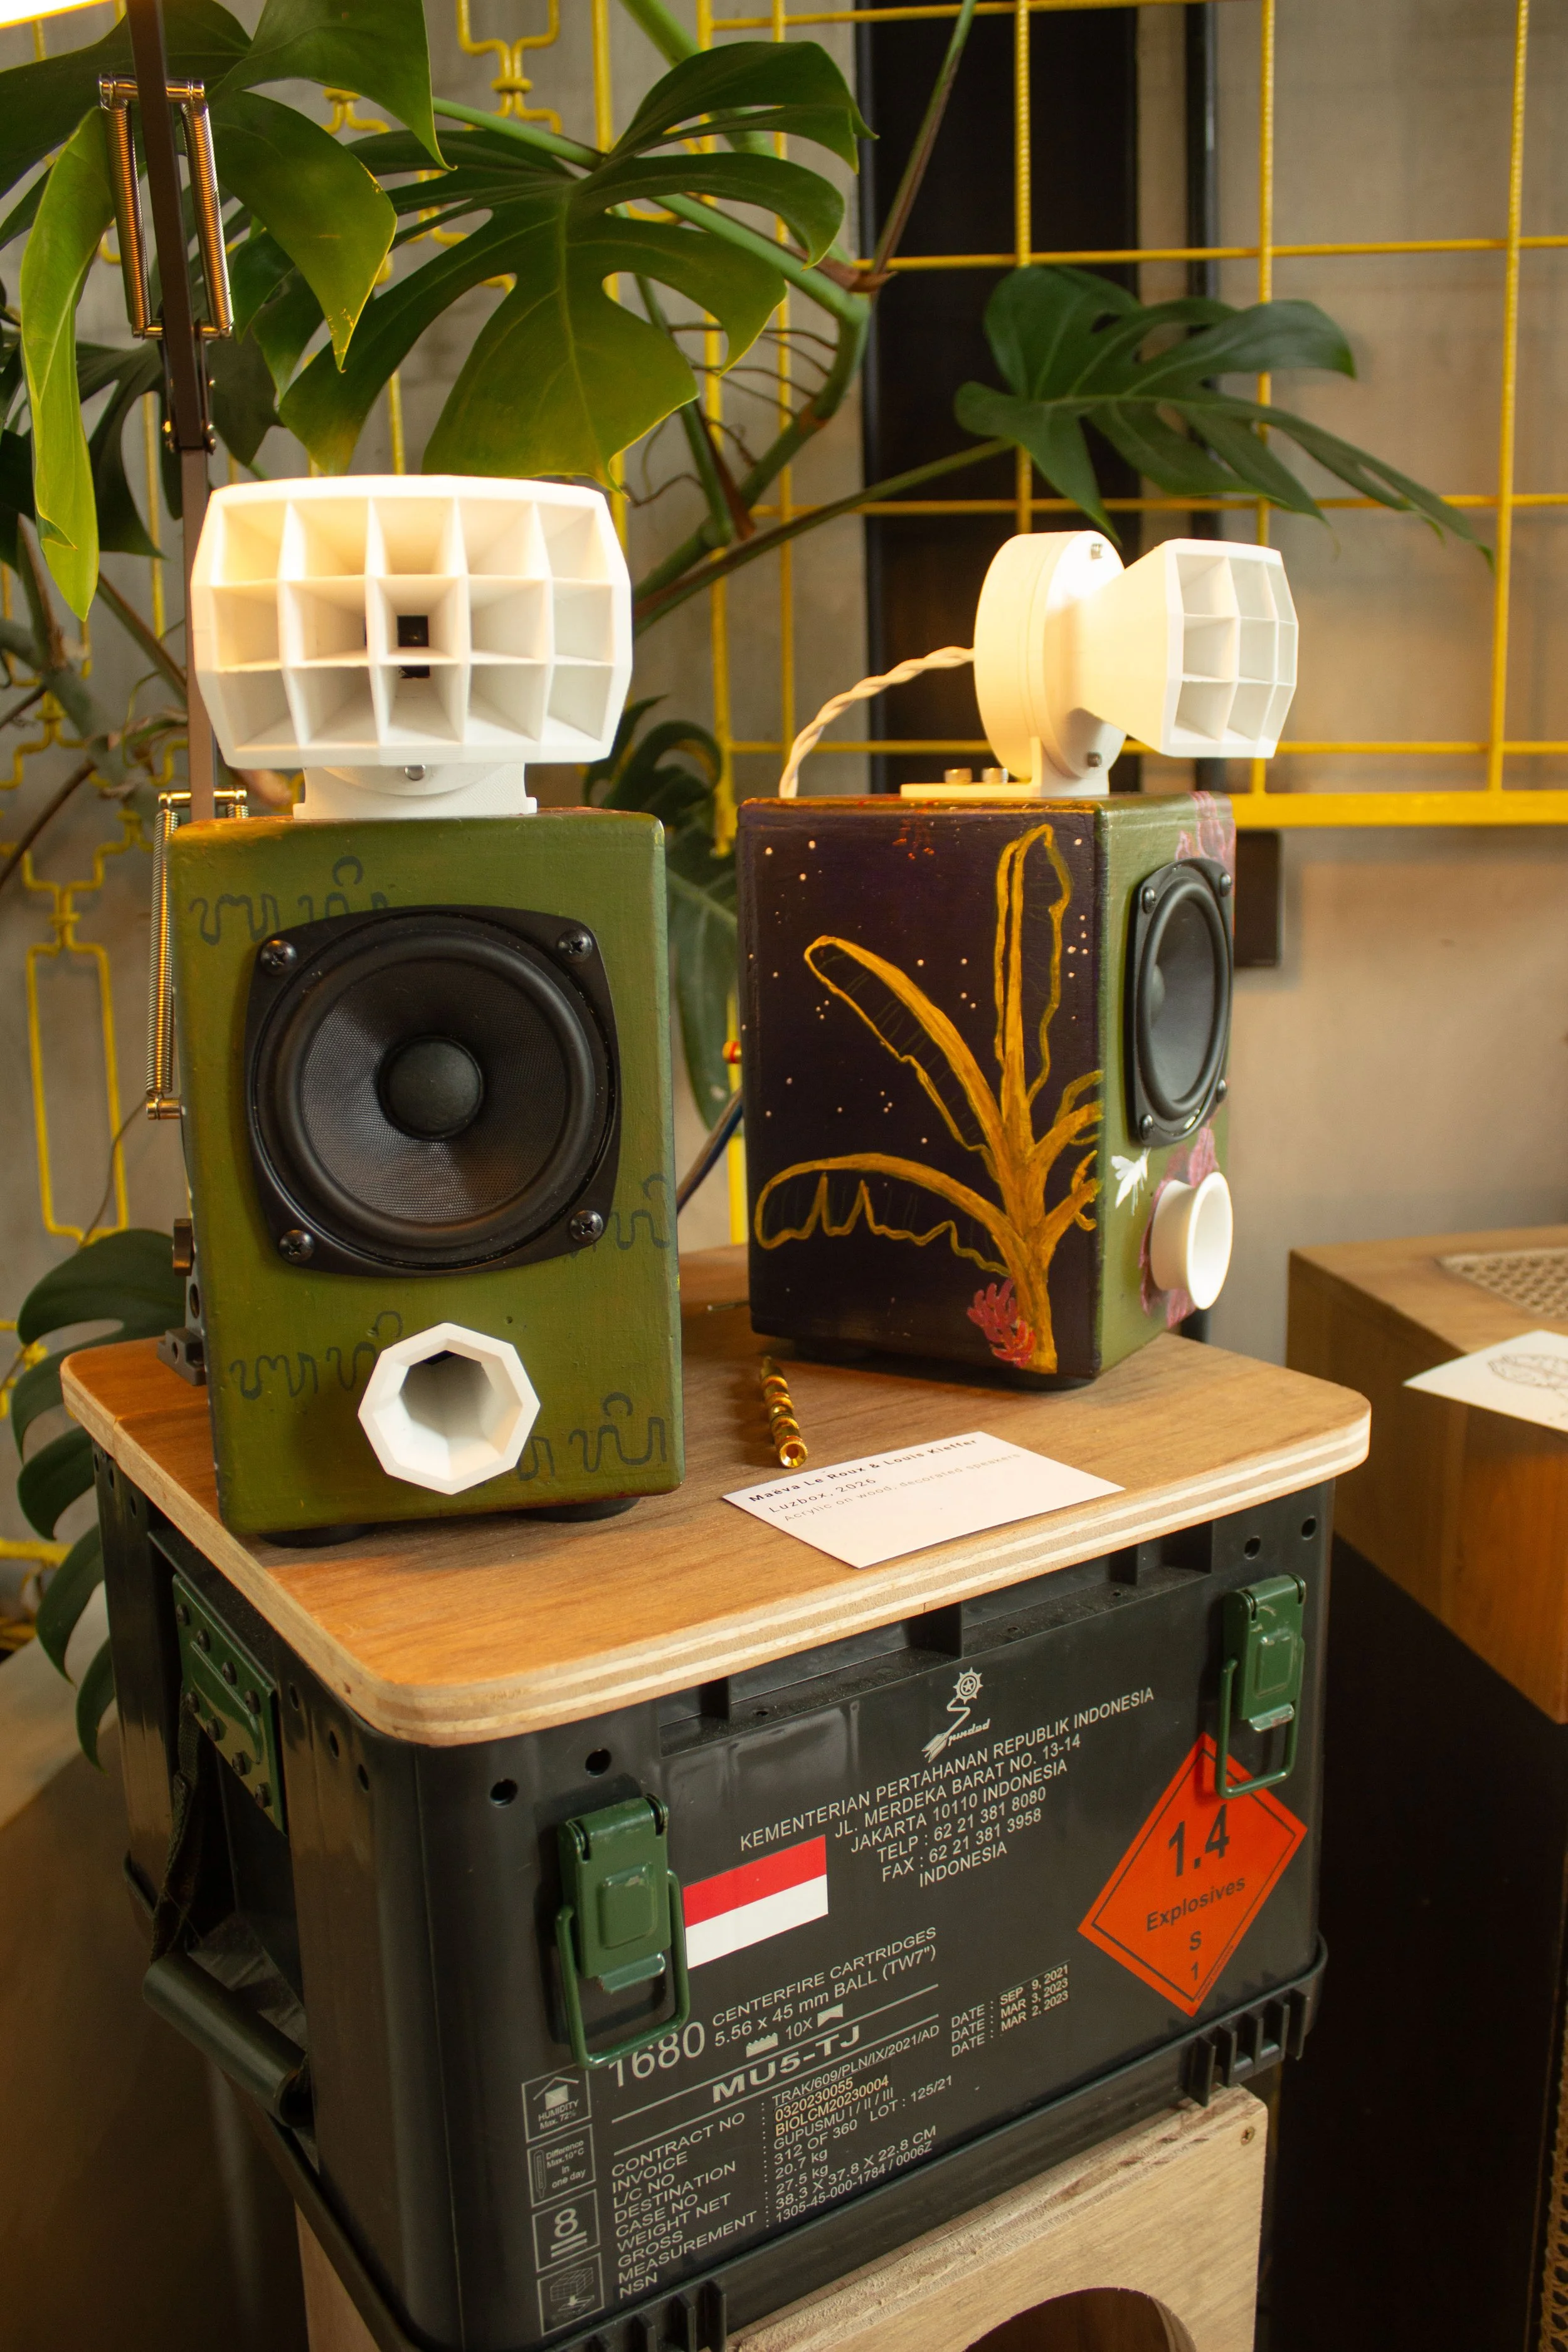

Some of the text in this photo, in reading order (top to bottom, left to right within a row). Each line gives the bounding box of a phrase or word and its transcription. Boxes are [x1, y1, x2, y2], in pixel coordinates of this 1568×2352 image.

[748, 1485, 800, 1502] Maëva
[803, 1478, 824, 1486] Le
[827, 1467, 866, 1480] Roux
[883, 1453, 924, 1465] Louis
[927, 1439, 977, 1454] Kieffer
[769, 1478, 876, 1513] Luzbox, 2026
[784, 1453, 1021, 1522] Acrylic on wood, decorated speakers
[740, 1687, 1155, 1851] KEMENTERIAN PERTAHANAN REPUBLIK INDONESIA
[835, 1734, 1081, 1838] JL. MERDEKA BARAT NO. 13-14
[850, 1759, 1067, 1853] JAKARTA 10110 INDONESIA
[877, 1836, 918, 1863] TELP
[933, 1823, 952, 1842] 62
[957, 1814, 973, 1834] 21
[980, 1801, 1005, 1825] 381
[1011, 1786, 1046, 1812] 8080
[1168, 1803, 1230, 1878] 1.4
[882, 1857, 914, 1882] FAX
[929, 1845, 948, 1864] 62
[952, 1836, 969, 1855] 21
[975, 1823, 1000, 1846] 381
[1007, 1808, 1042, 1833] 3958
[919, 1841, 1007, 1887] INDONESIA
[1147, 1877, 1246, 1932] Explosives
[712, 1926, 936, 2027] CENTERFIRE CARTRIDGES
[1189, 1931, 1202, 1951] S
[1190, 1961, 1199, 1981] 1
[714, 2020, 753, 2047] 5.56
[757, 2016, 768, 2030] x
[771, 2003, 793, 2023] 45
[798, 1991, 829, 2013] mm
[834, 1969, 878, 1998] BALL
[785, 2017, 813, 2040] 10X
[951, 2004, 985, 2028] DATE
[1000, 1986, 1024, 2006] SEP
[1031, 1979, 1041, 1991] 9,
[1044, 1964, 1069, 1984] 2021
[951, 2018, 985, 2043] DATE
[1000, 1998, 1027, 2019] MAR
[1031, 1992, 1041, 2004] 3,
[1044, 1977, 1069, 1998] 2023
[951, 2033, 985, 2057] DATE
[1001, 2011, 1027, 2032] MAR
[1031, 2005, 1041, 2017] 2,
[1044, 1989, 1069, 2011] 2023
[608, 2021, 705, 2088] 1680
[712, 2025, 860, 2103] MU5-TJ
[538, 2099, 579, 2121] HUMIDITY
[539, 2111, 576, 2130] Max. 72%
[612, 2124, 714, 2177] CONTRACT
[719, 2112, 745, 2132] NO
[772, 2025, 940, 2106] TRAK/609/PLN/IX/2021/AD
[612, 2151, 688, 2194] INVOICE
[775, 2076, 854, 2122] 0320230055
[546, 2140, 584, 2160] Difference
[561, 2165, 569, 2175] in
[613, 2188, 642, 2209] L/C
[648, 2173, 675, 2194] NO
[775, 2074, 889, 2136] BIOLCM20230004
[615, 2161, 736, 2224] DESTINATION
[774, 2110, 845, 2150] GUPUSMU
[849, 2106, 852, 2117] I
[856, 2102, 861, 2114] /
[864, 2098, 872, 2110] II
[874, 2094, 879, 2106] /
[882, 2087, 894, 2102] III
[616, 2207, 666, 2238] CASE
[671, 2194, 698, 2214] NO
[774, 2144, 803, 2165] 312
[807, 2131, 829, 2151] OF
[832, 2119, 857, 2139] 360
[870, 2099, 899, 2122] LOT
[911, 2075, 953, 2102] 125/21
[551, 2168, 586, 2189] one day
[617, 2211, 690, 2253] WEIGHT
[696, 2192, 731, 2218] NET
[775, 2157, 807, 2180] 20.7
[811, 2149, 829, 2164] kg
[619, 2211, 758, 2284] MEASUREMENT
[775, 2187, 808, 2210] 38.3
[812, 2179, 824, 2193] X
[828, 2163, 859, 2186] 37.8
[863, 2154, 874, 2169] X
[878, 2139, 908, 2162] 22.8
[913, 2125, 936, 2144] CM
[554, 2207, 579, 2238] 8
[618, 2230, 684, 2268] GROSS
[776, 2172, 808, 2196] 27.5
[812, 2164, 829, 2179] kg
[620, 2272, 657, 2299] NSN
[776, 2163, 886, 2223] 1305-45-000-1784
[896, 2140, 933, 2167] 0006Z
